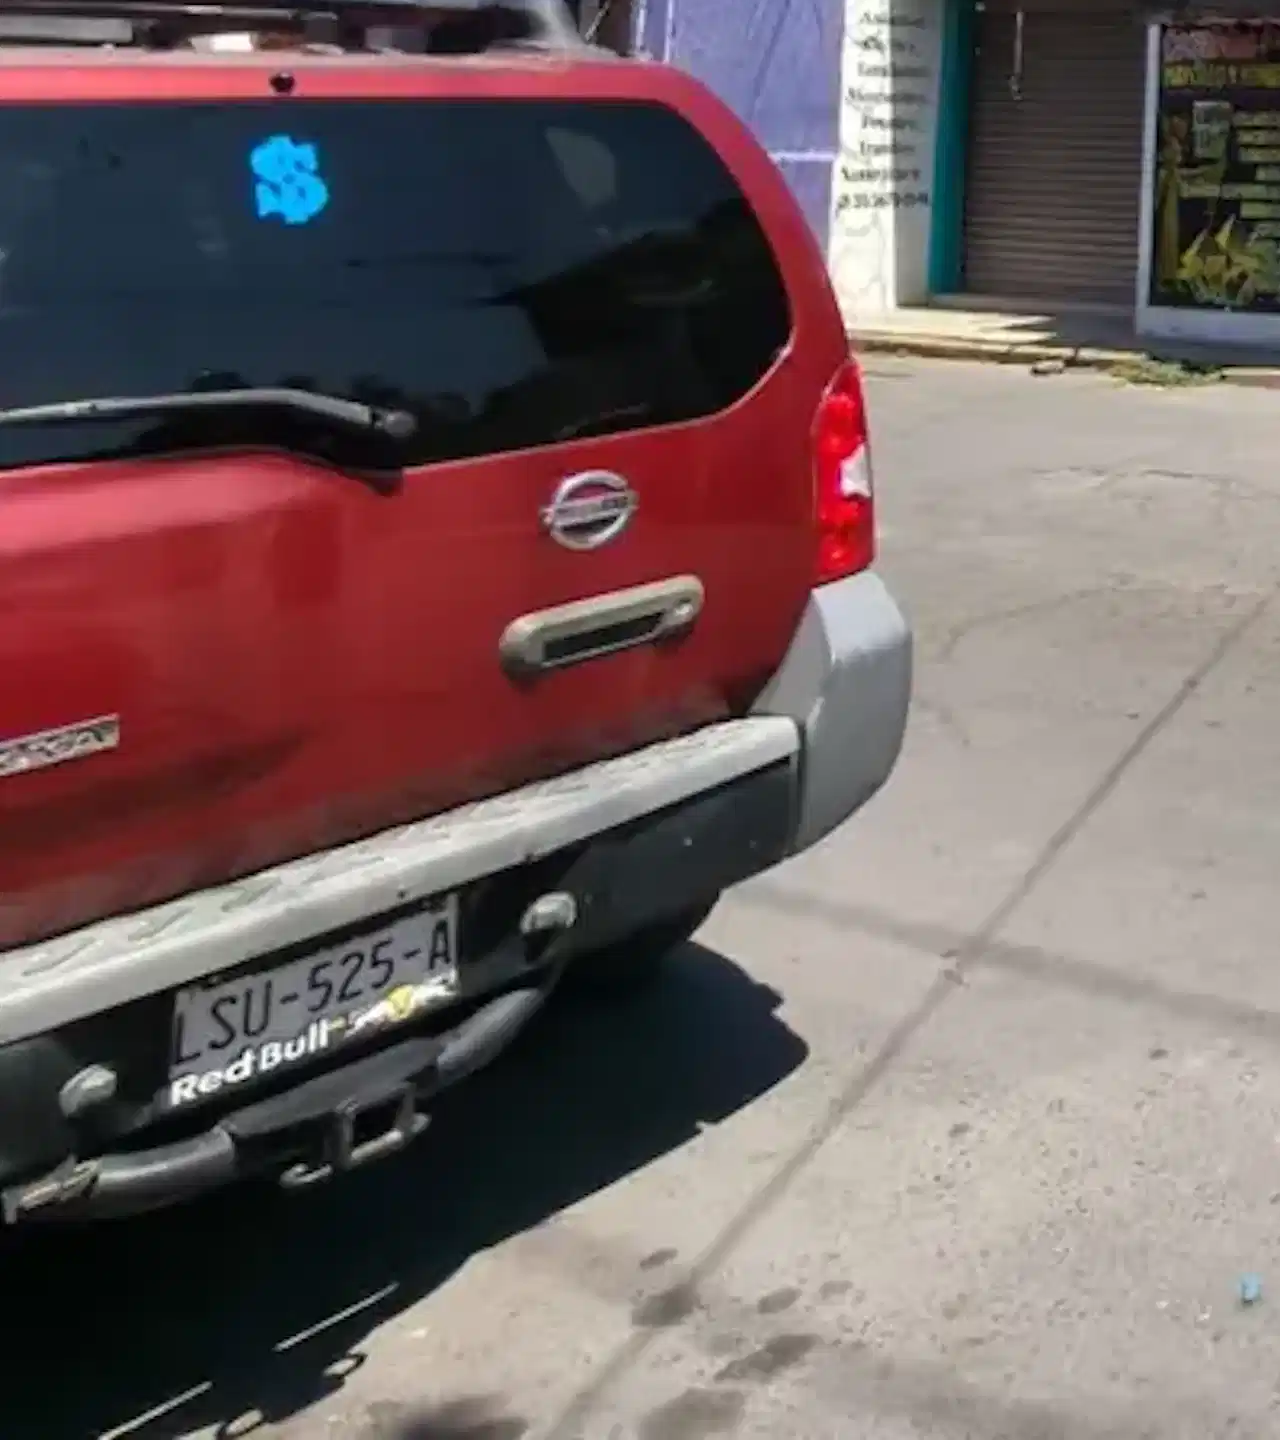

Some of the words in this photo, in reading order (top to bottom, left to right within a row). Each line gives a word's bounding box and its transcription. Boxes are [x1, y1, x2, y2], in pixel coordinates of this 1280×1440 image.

[174, 918, 453, 1064] LSU-525-A
[170, 1044, 256, 1106] Red
[257, 1015, 330, 1073] Bull
